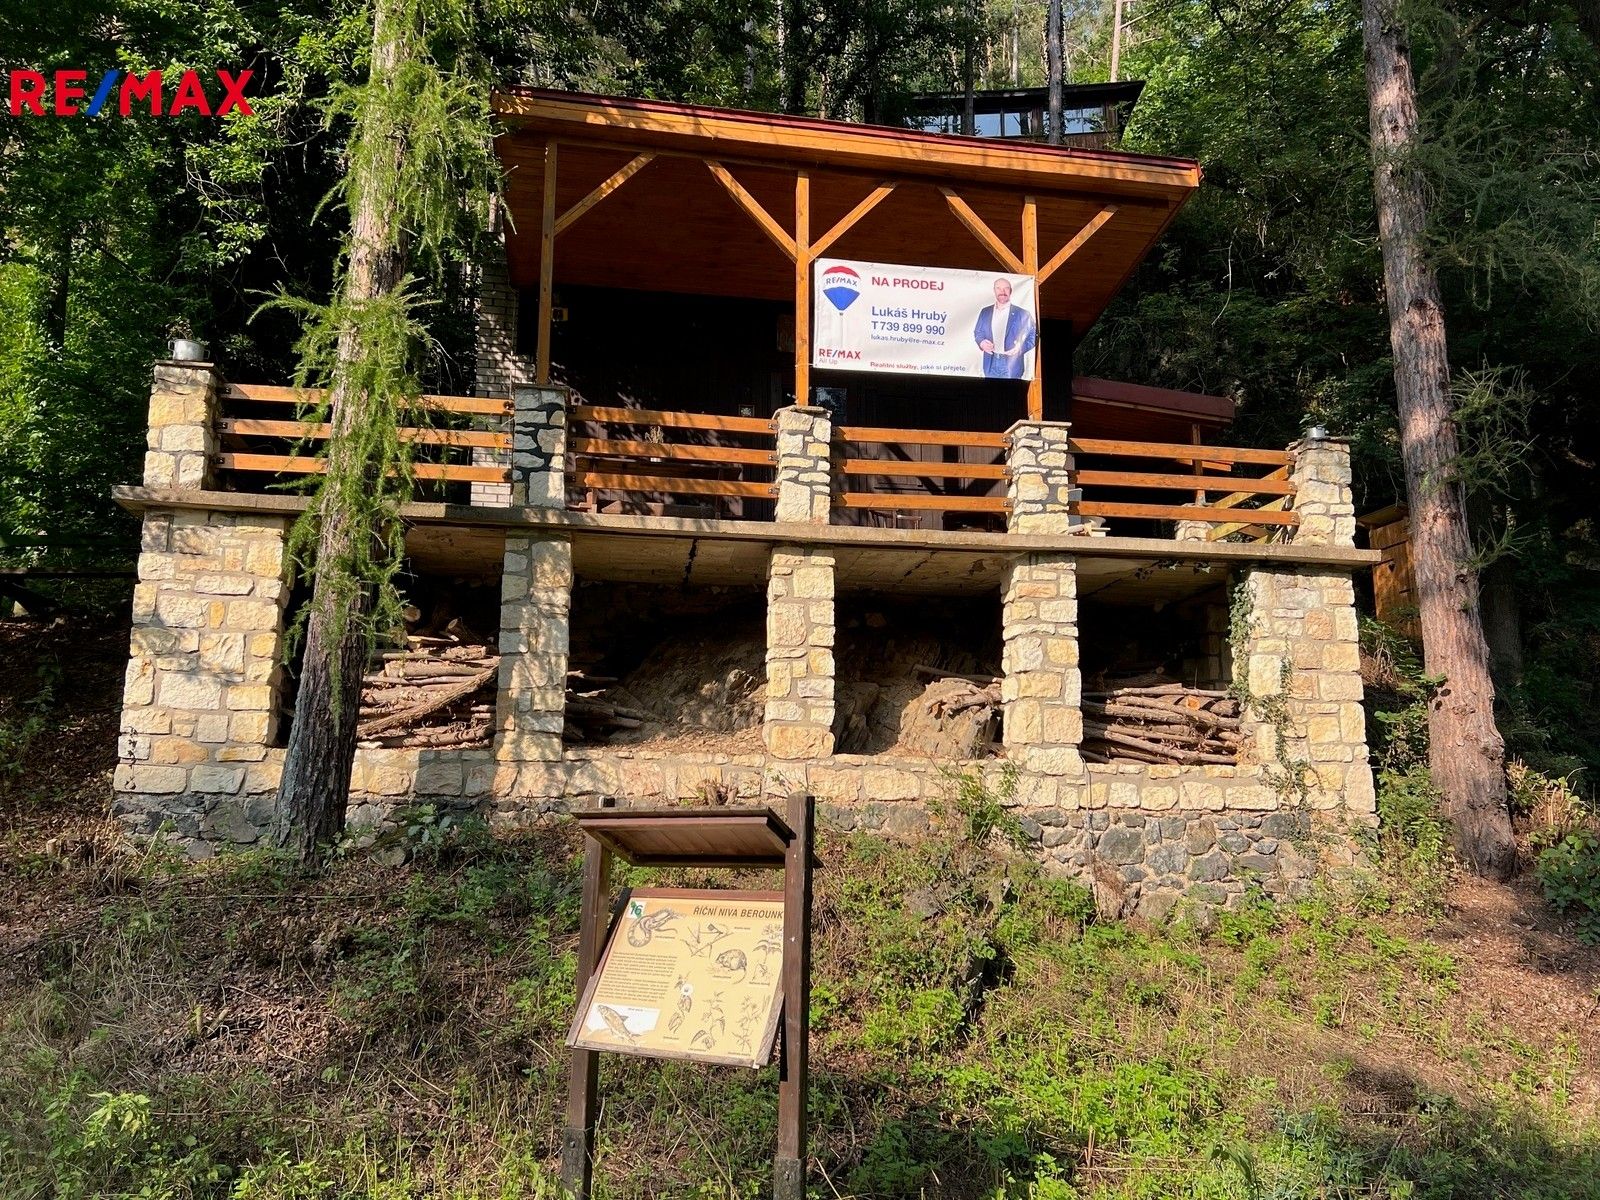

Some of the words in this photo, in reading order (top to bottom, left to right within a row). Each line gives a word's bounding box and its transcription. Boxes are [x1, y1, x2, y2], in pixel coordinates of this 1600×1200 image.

[825, 276, 858, 287] RE/MAX
[871, 276, 890, 287] NA
[893, 278, 944, 291] PRODEJ
[871, 306, 908, 319] Lukáš
[911, 309, 947, 323] Hrubý
[902, 323, 923, 334] 899
[925, 325, 946, 336] 990
[818, 348, 861, 360] RE/MAX
[693, 905, 718, 916] ŘÍČNÍ
[718, 906, 738, 917] NIVA
